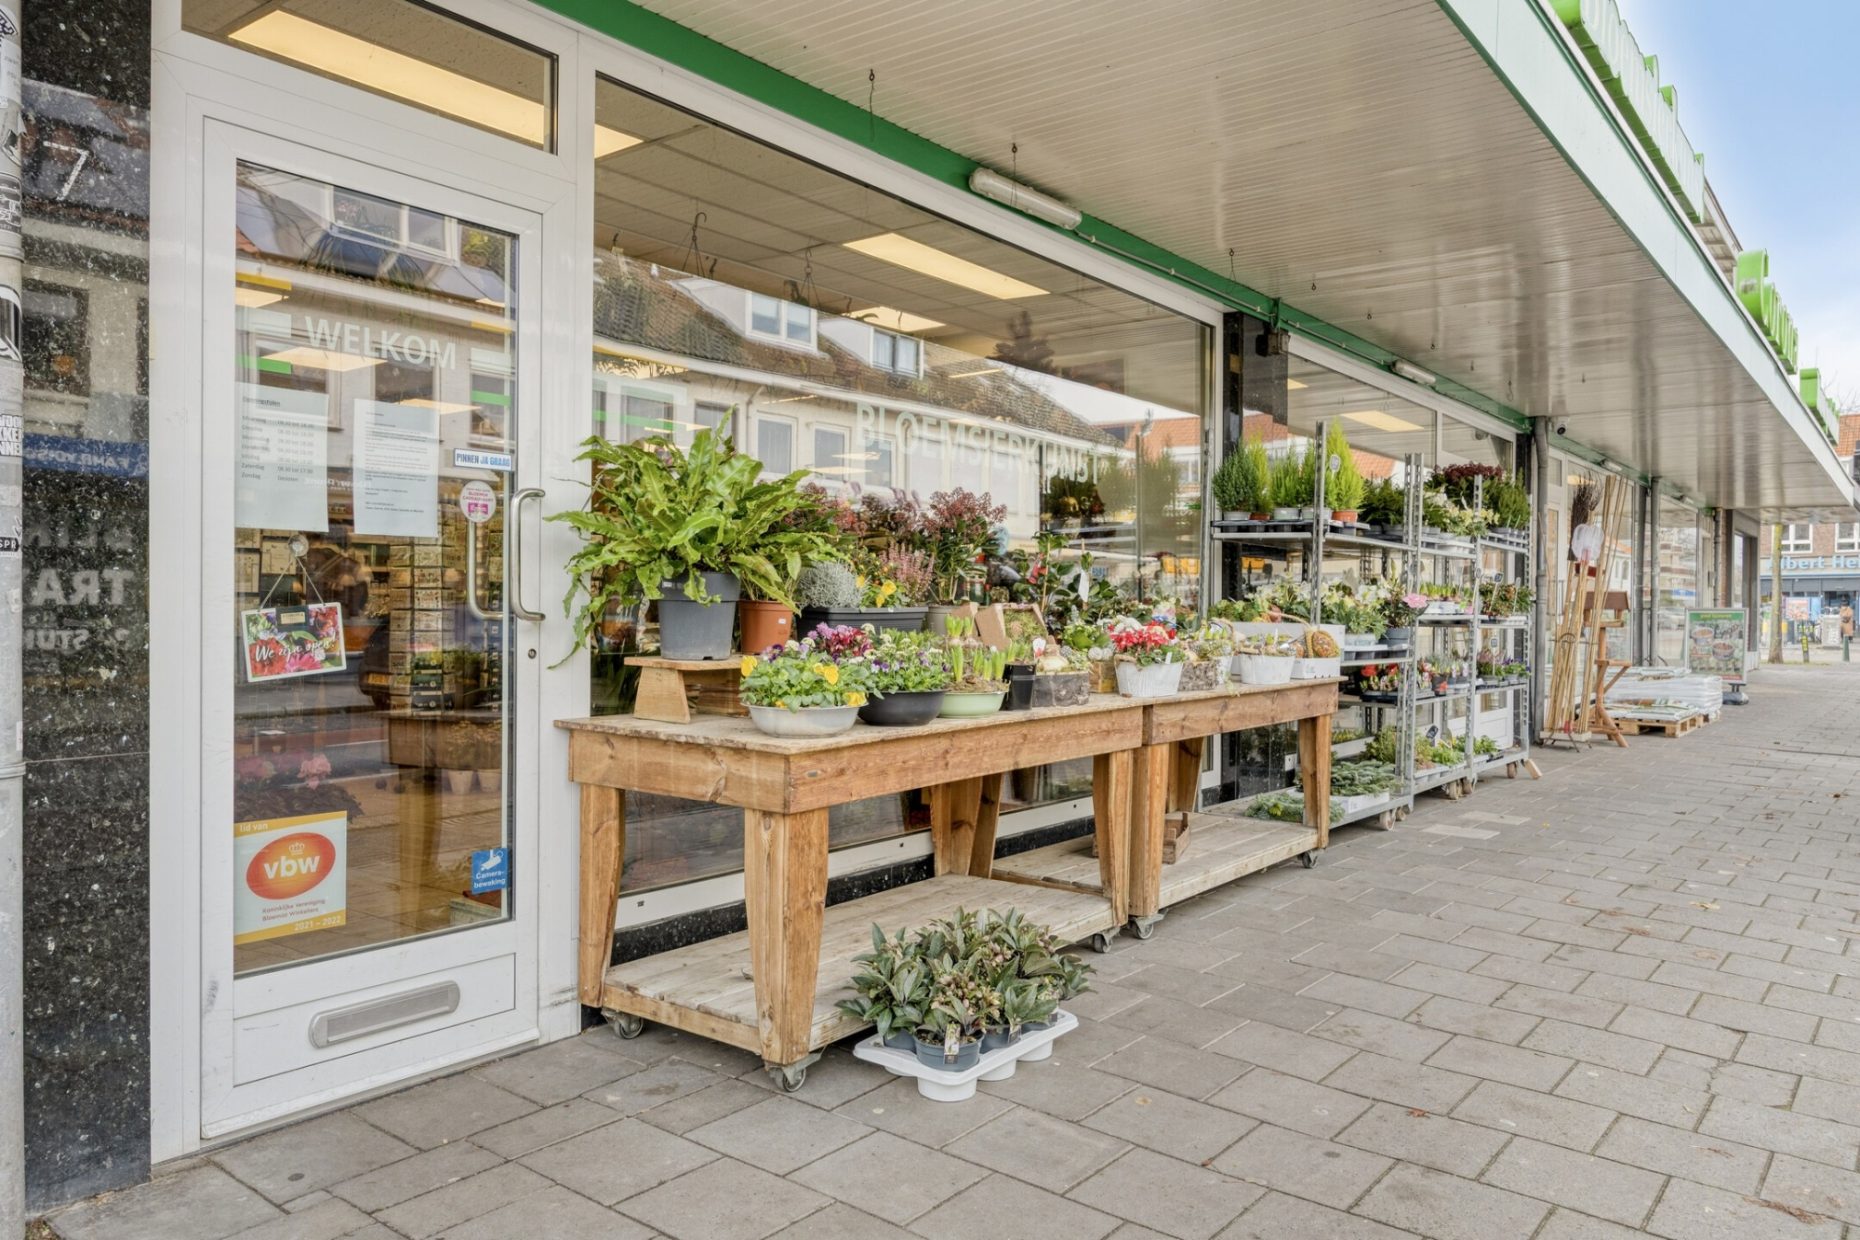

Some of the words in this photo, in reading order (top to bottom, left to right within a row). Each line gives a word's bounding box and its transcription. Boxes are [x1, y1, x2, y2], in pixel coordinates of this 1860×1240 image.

[305, 316, 456, 370] WELKOM
[856, 401, 1100, 488] BLOEMSIERKUNST
[456, 453, 480, 465] PINNEN
[480, 456, 489, 465] JA
[255, 645, 275, 663] We
[279, 643, 303, 661] zijn
[305, 632, 336, 653] open!
[240, 824, 251, 832] lid
[253, 822, 268, 830] van
[264, 856, 320, 879] vbw
[294, 920, 314, 931] 2021
[323, 916, 342, 926] 2022
